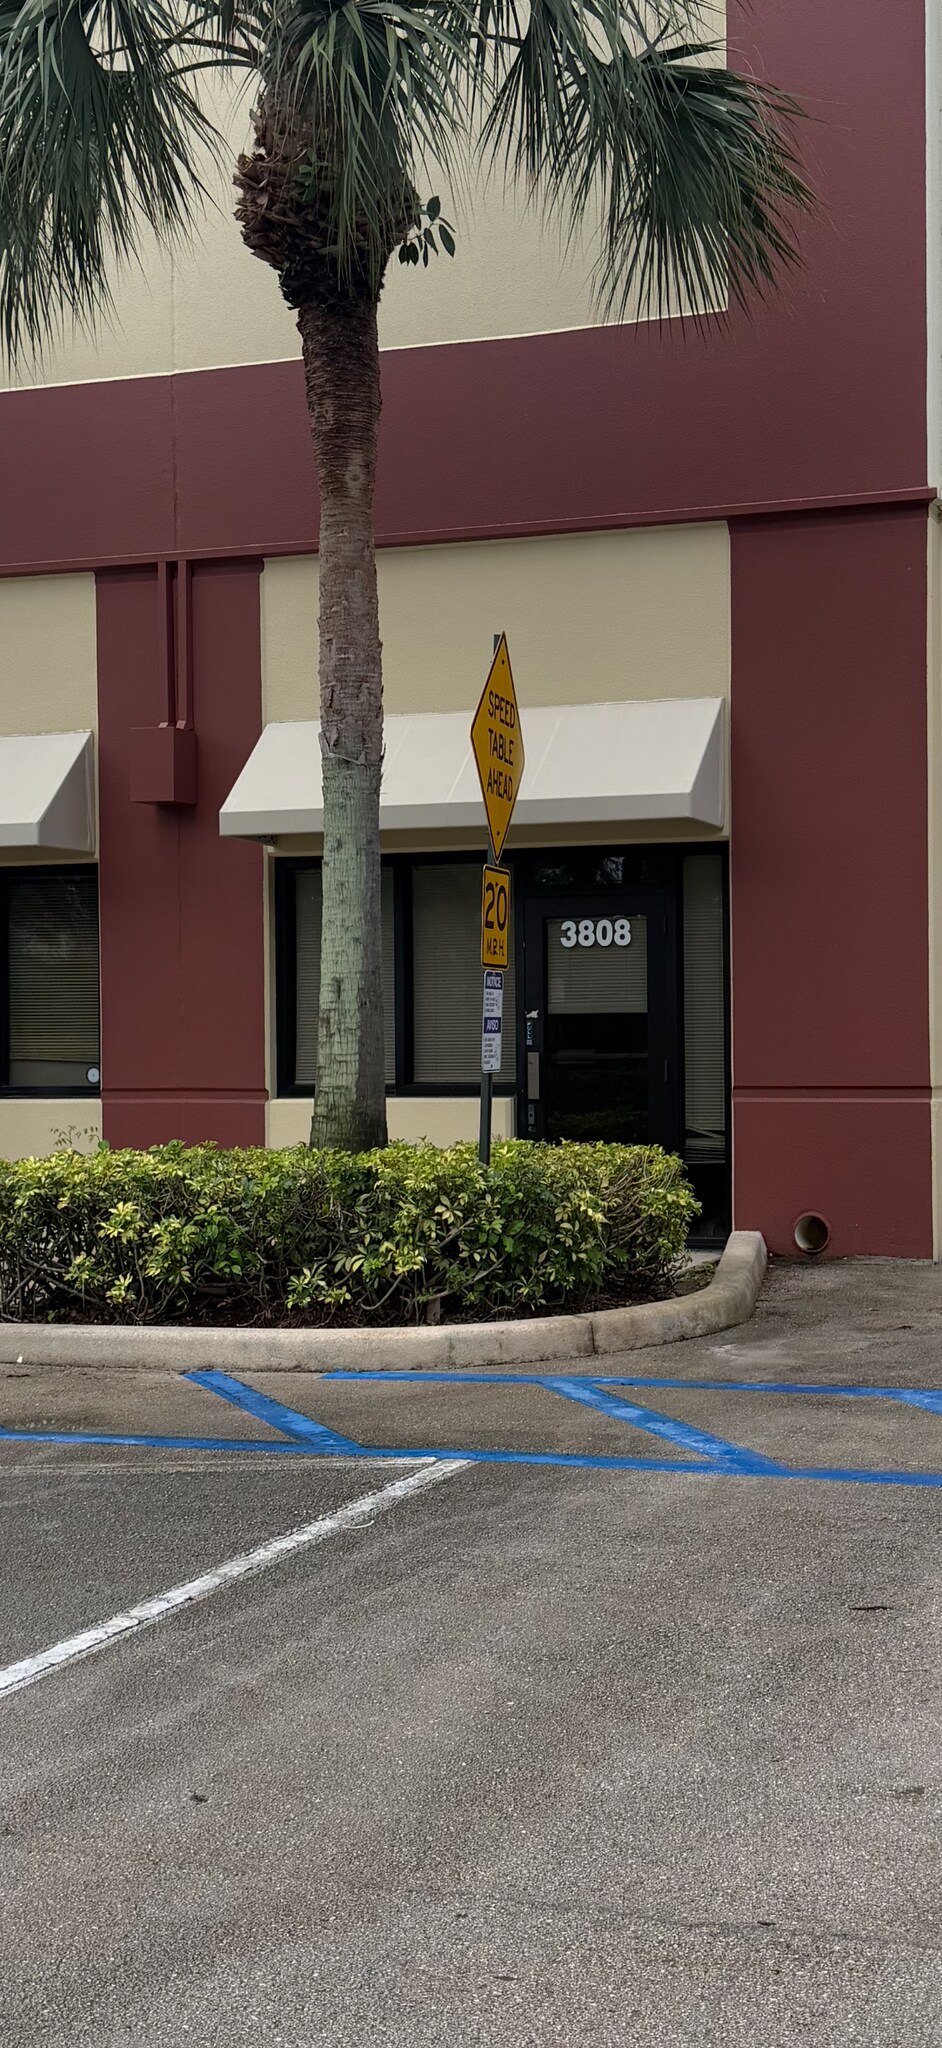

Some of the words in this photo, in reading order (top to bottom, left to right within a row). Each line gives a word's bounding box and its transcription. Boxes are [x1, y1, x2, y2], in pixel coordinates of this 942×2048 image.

[488, 690, 515, 729] SPEED
[488, 728, 514, 766] TABLE
[487, 766, 513, 802] AHEAD
[485, 882, 507, 932] 20
[560, 918, 632, 948] 3808
